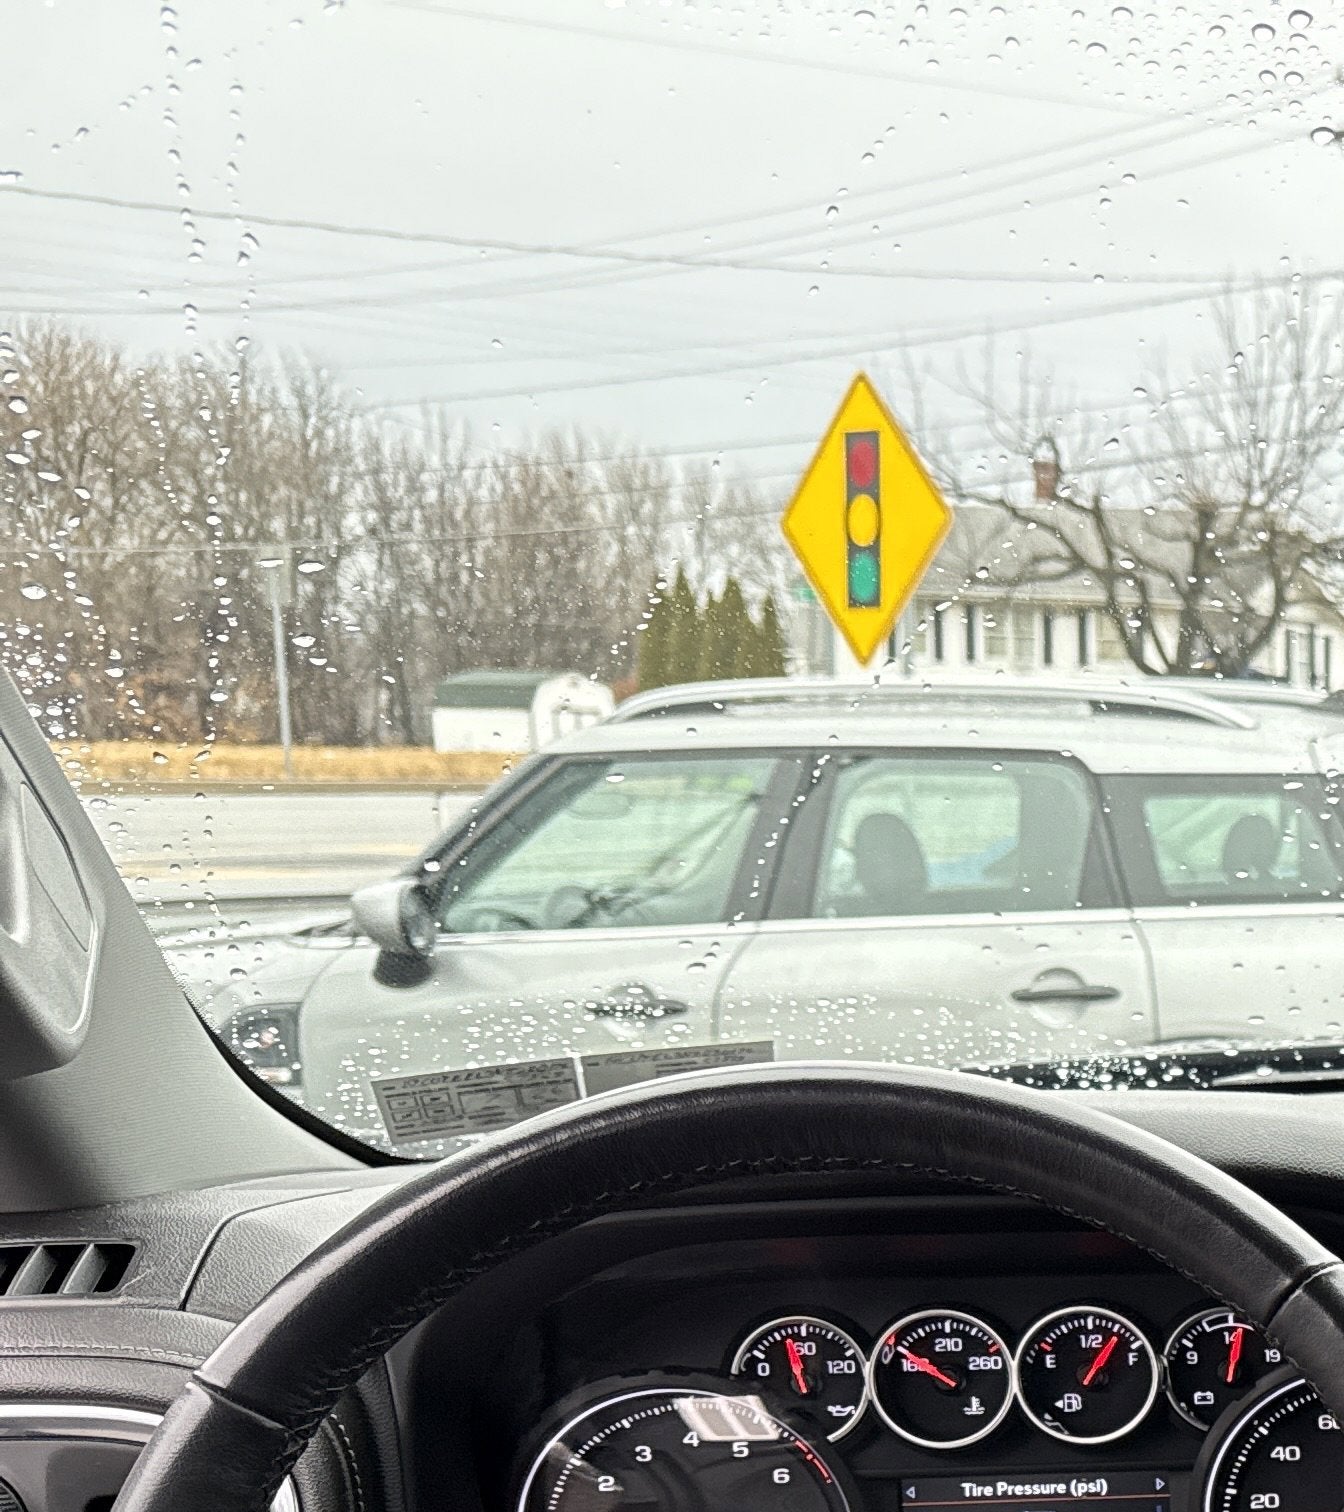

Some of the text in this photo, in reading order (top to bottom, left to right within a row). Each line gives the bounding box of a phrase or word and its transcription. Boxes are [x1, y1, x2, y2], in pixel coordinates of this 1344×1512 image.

[794, 1341, 817, 1356] 60
[934, 1338, 963, 1352] 210
[1080, 1334, 1103, 1348] 1/2
[968, 1356, 1003, 1371] 260
[1045, 1354, 1056, 1369] E
[1128, 1352, 1139, 1366] F
[1186, 1351, 1198, 1365] 9
[1264, 1349, 1281, 1363] 19
[757, 1362, 770, 1377] 0
[827, 1360, 856, 1374] 120
[682, 1431, 700, 1447] 4
[635, 1446, 652, 1463] 3
[732, 1441, 750, 1458] 5
[1270, 1446, 1301, 1461] 40
[773, 1467, 790, 1484] 6
[598, 1476, 616, 1492] 2
[961, 1478, 1108, 1498] Tire Pressure (psi)
[1250, 1493, 1280, 1509] 20
